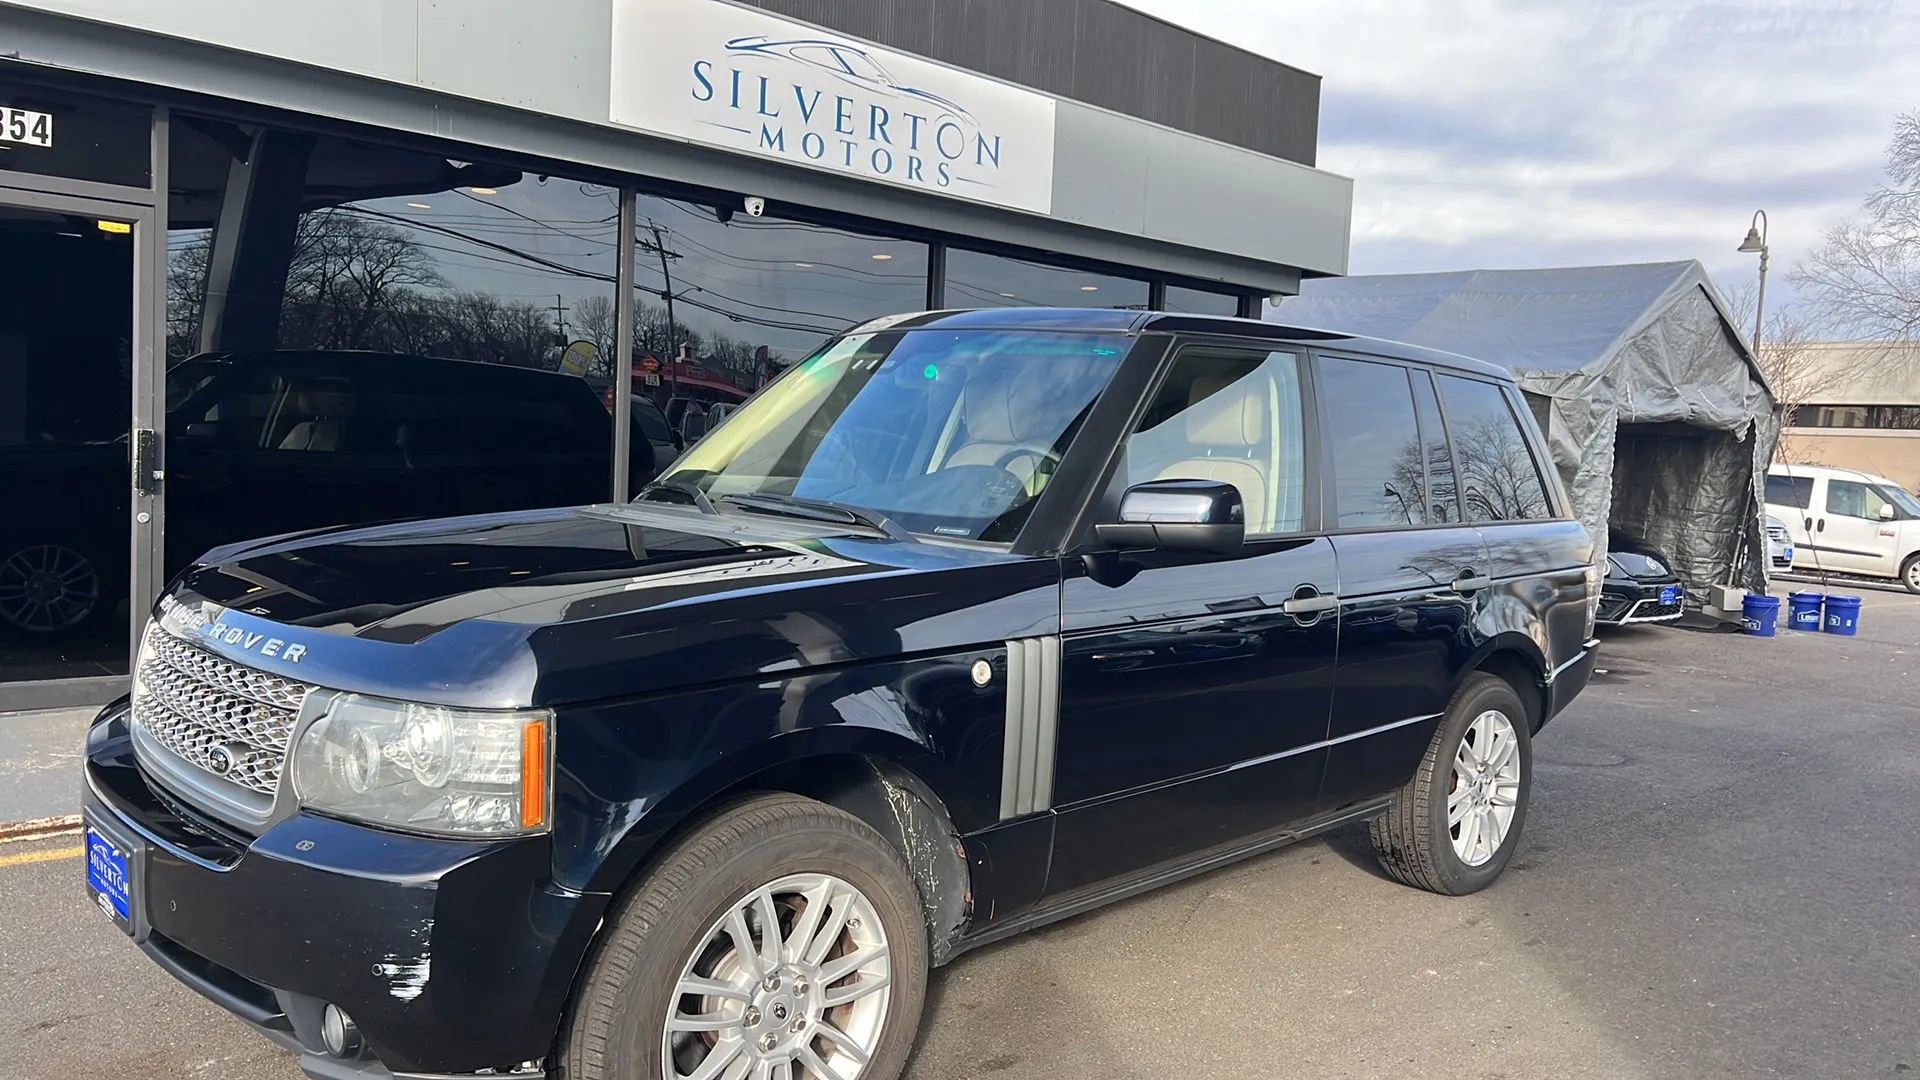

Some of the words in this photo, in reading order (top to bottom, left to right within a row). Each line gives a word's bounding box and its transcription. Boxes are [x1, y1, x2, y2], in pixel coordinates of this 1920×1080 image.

[0, 108, 49, 144] 54
[691, 60, 1001, 170] SILVERTON
[760, 121, 951, 188] MOTORS
[208, 622, 308, 664] ROVER
